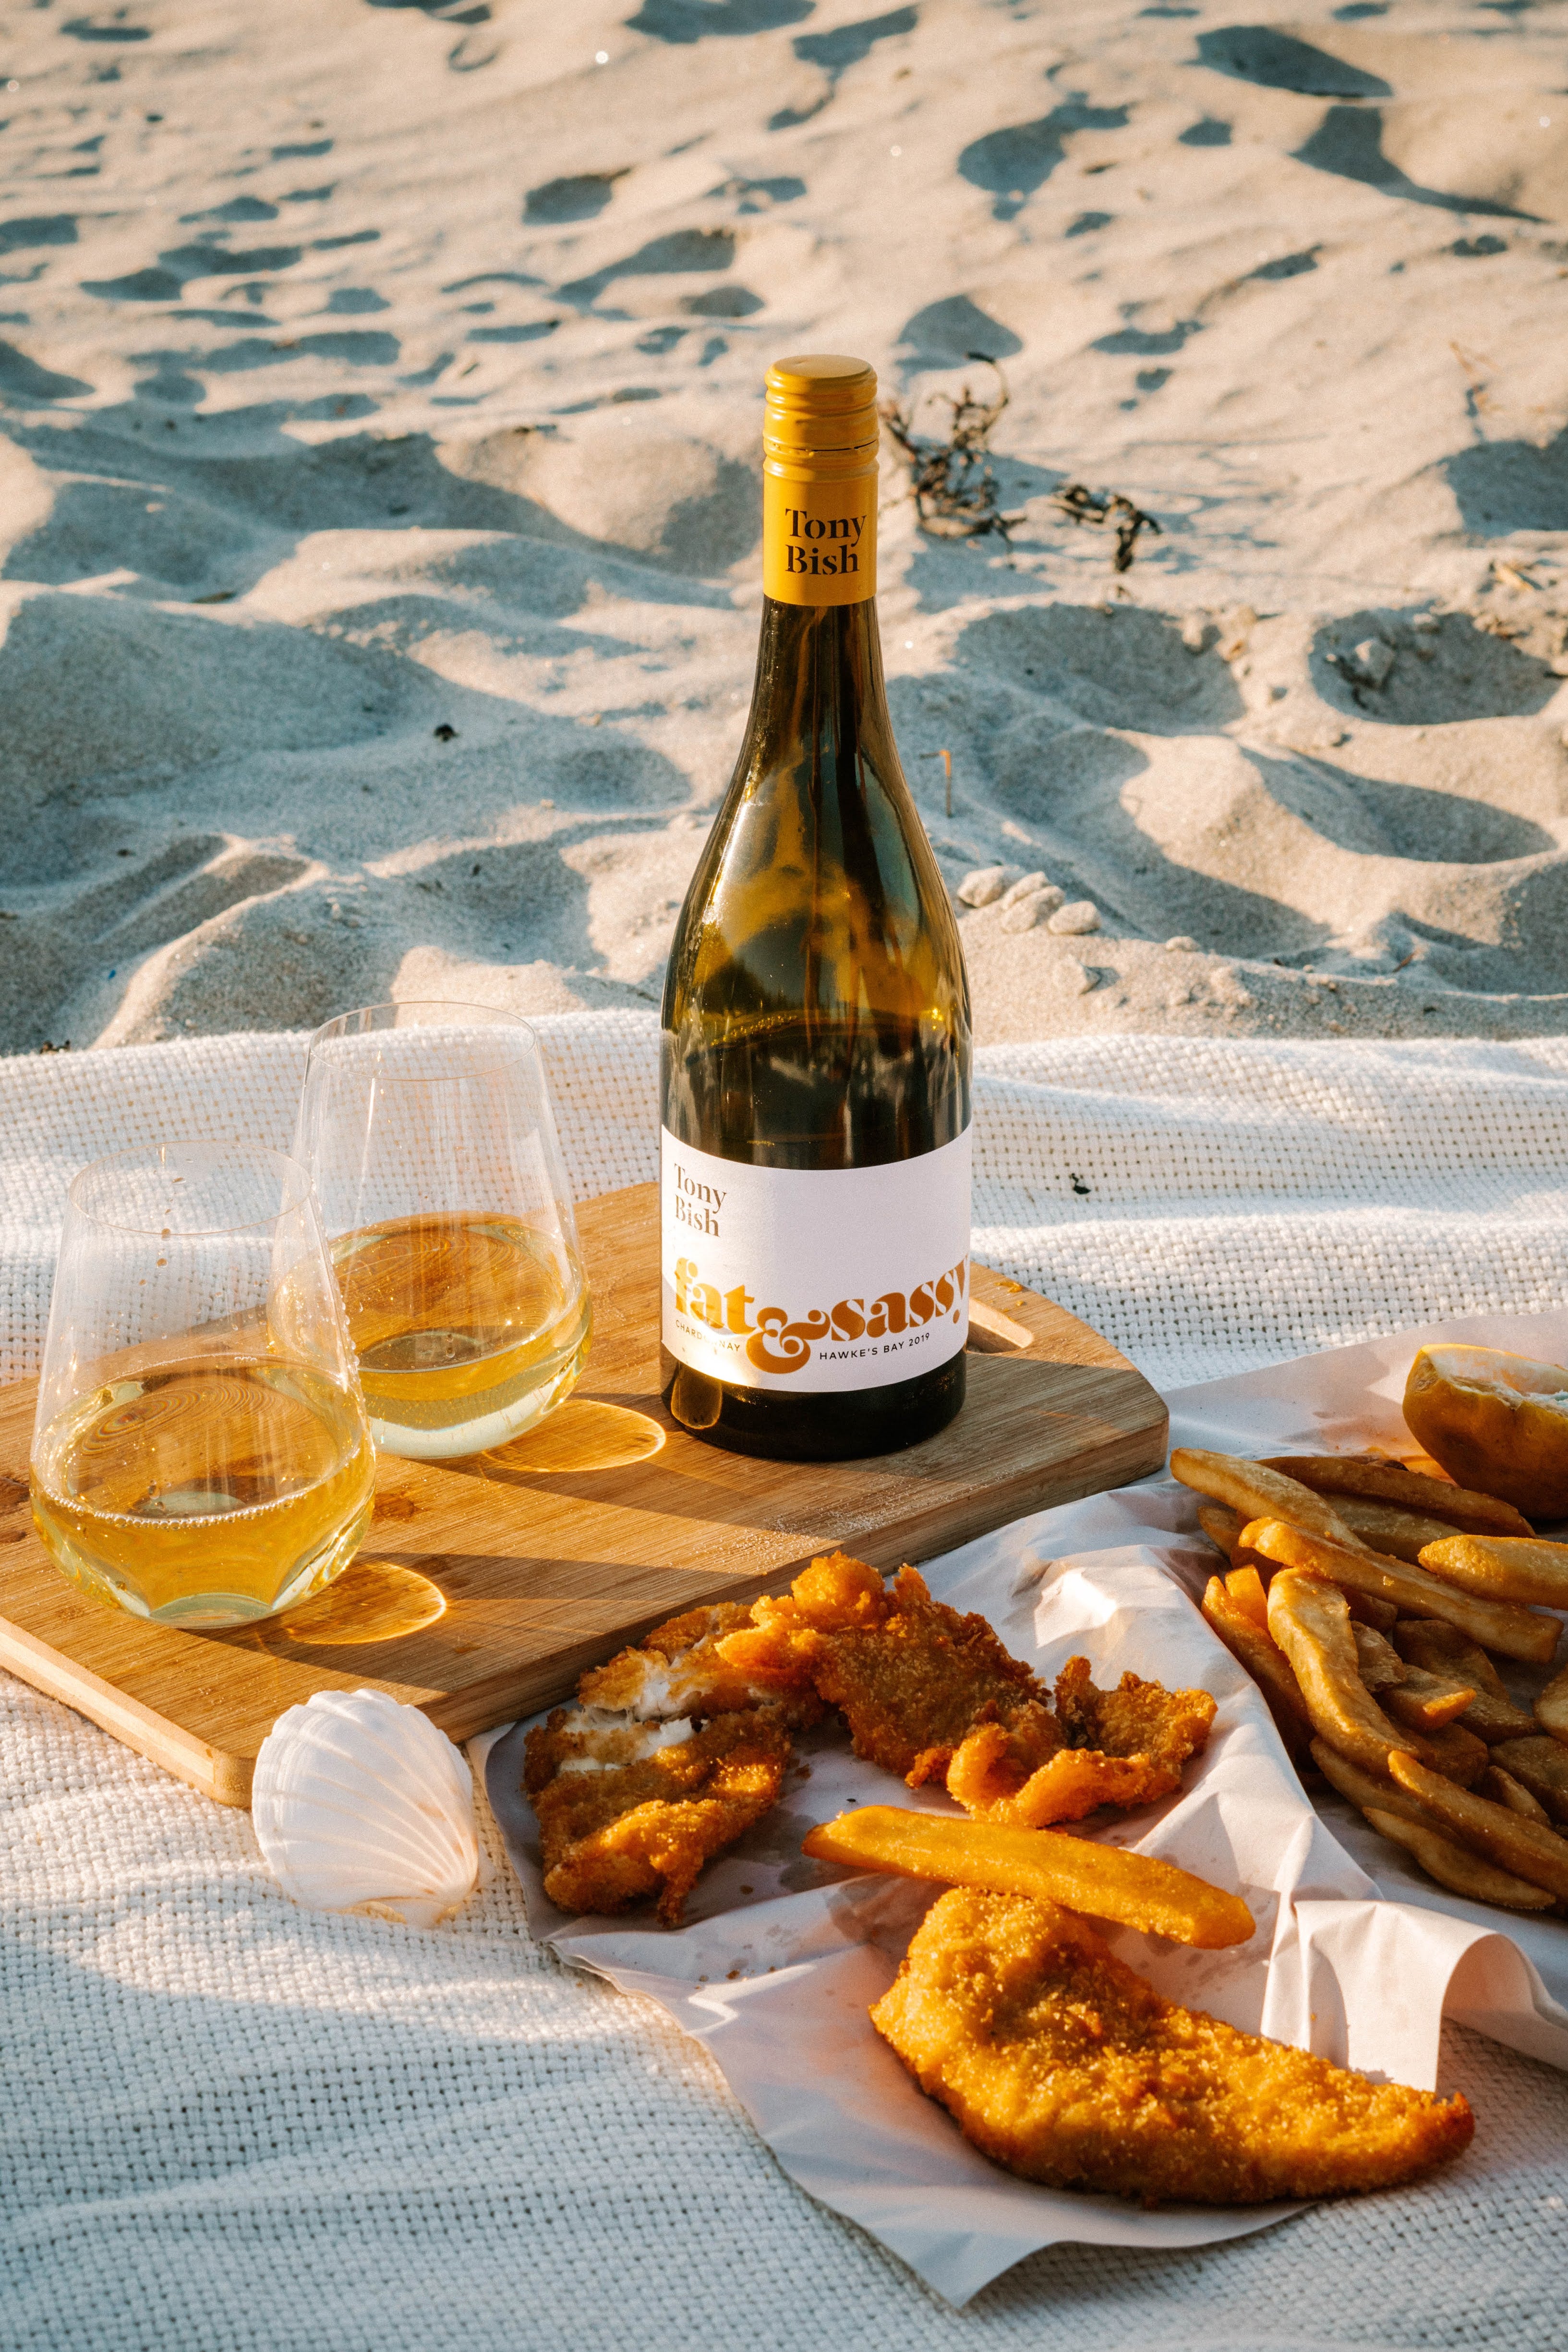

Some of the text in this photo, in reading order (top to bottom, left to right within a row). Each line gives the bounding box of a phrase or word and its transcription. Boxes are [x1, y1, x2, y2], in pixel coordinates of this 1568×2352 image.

[785, 508, 867, 546] Tony
[785, 543, 860, 575] Bish
[674, 1163, 727, 1214] Tony
[675, 1194, 720, 1237] Bish
[674, 1257, 757, 1335] fat
[675, 1320, 740, 1351] CHARDNAY
[820, 1333, 930, 1360] HAWKE'S BAY 2019
